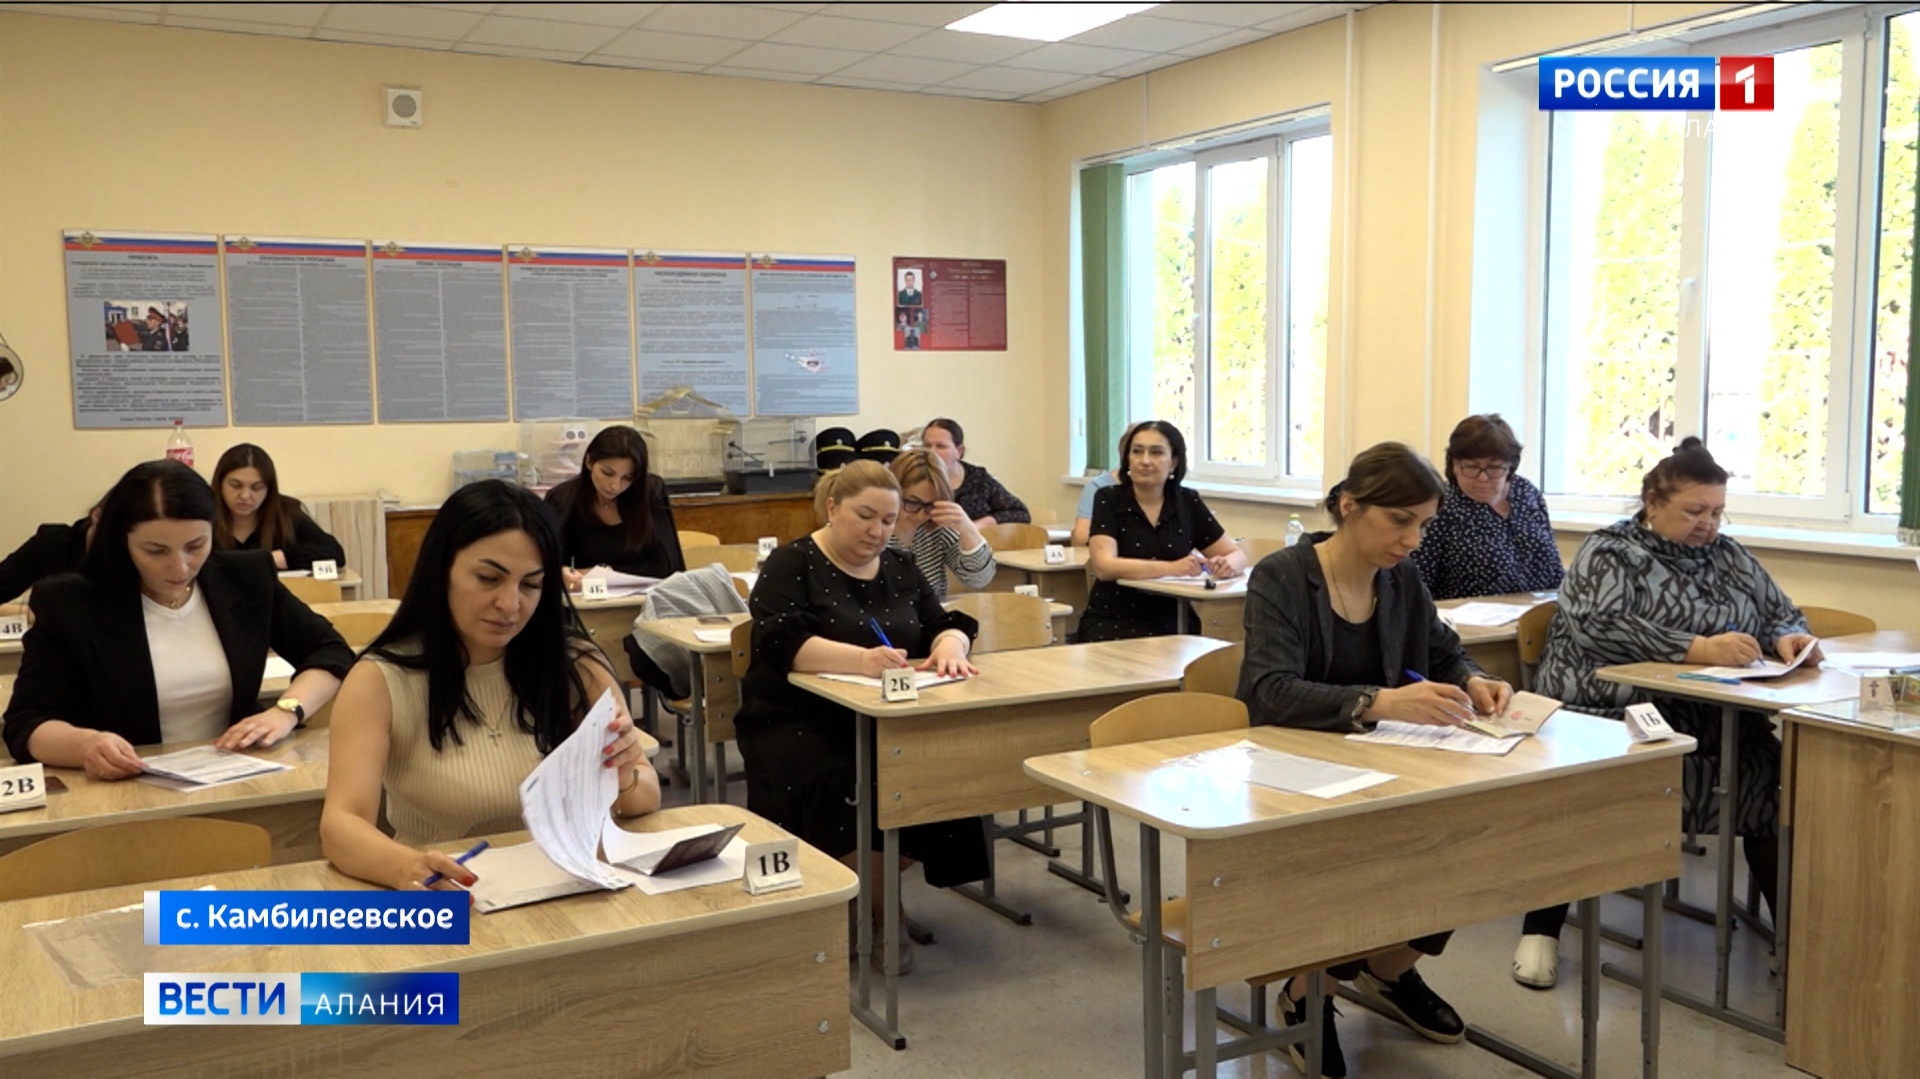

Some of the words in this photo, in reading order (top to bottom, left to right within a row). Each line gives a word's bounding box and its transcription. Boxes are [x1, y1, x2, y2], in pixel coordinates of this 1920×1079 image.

[890, 676, 911, 693] 2Б
[1, 776, 35, 797] 2В
[758, 850, 791, 877] 1В
